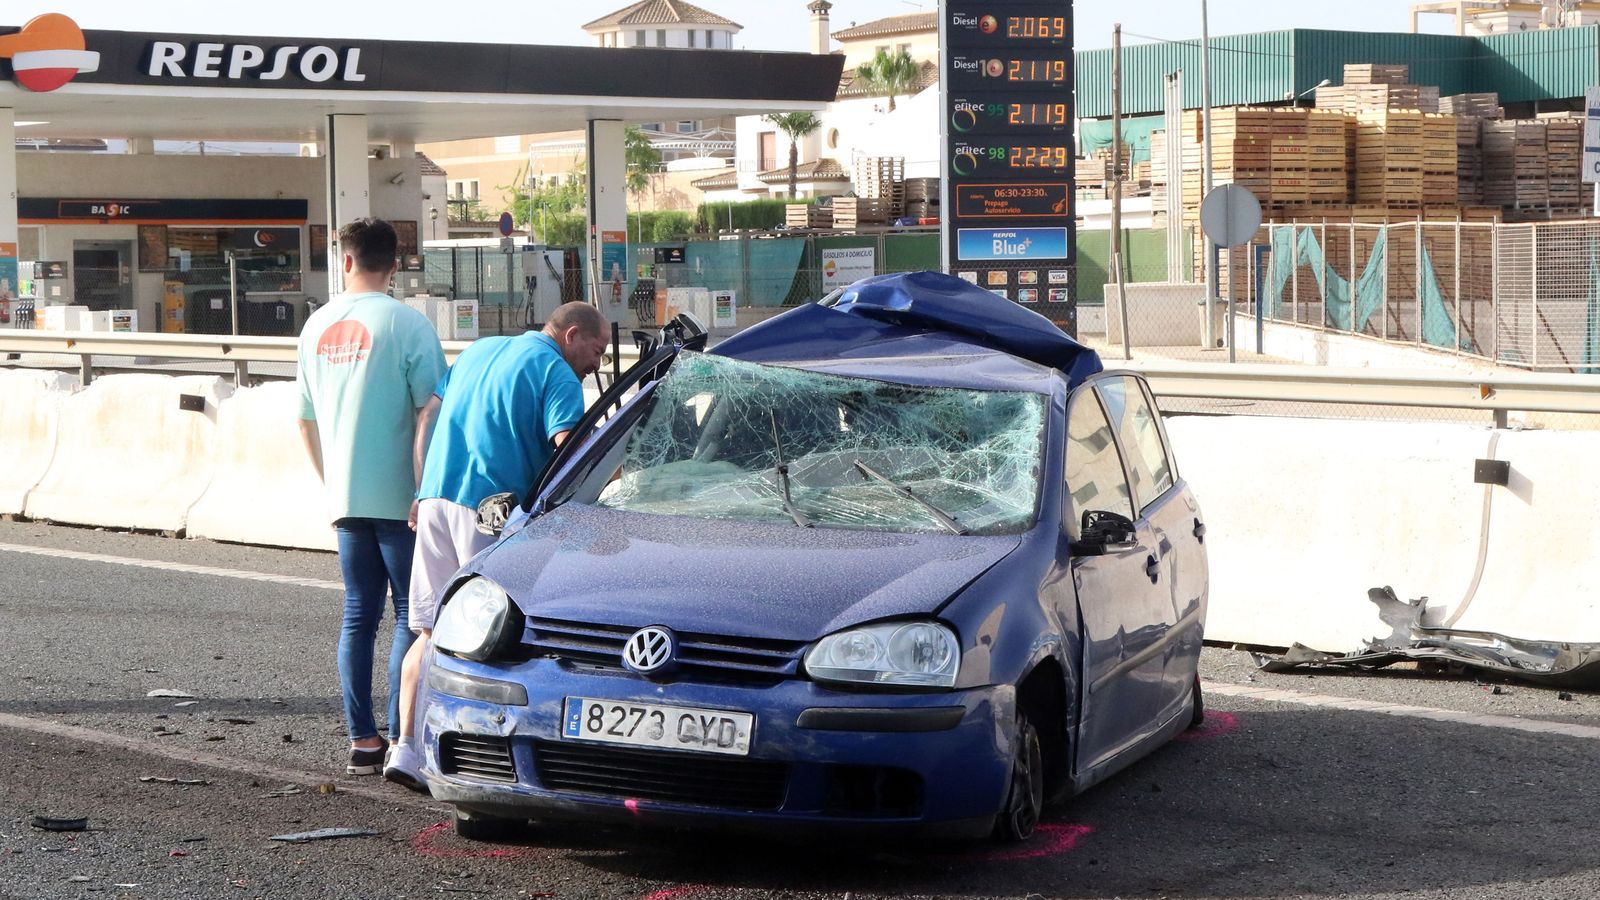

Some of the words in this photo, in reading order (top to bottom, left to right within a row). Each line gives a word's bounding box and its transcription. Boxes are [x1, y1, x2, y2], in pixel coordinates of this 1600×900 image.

[953, 16, 978, 25] Diesel
[1009, 17, 1064, 37] 2.069
[148, 41, 366, 82] REPSOL
[953, 60, 978, 69] Diesel
[1009, 60, 1065, 80] 2.119
[954, 102, 985, 112] efitec
[987, 104, 1005, 116] 95
[1009, 103, 1066, 124] 2.119
[955, 146, 986, 155] efitec
[988, 147, 1006, 160] 98
[1010, 147, 1067, 167] 2.229
[91, 203, 130, 216] BASIC
[984, 200, 1009, 208] Prepago
[569, 721, 577, 730] E
[586, 703, 665, 740] 8273
